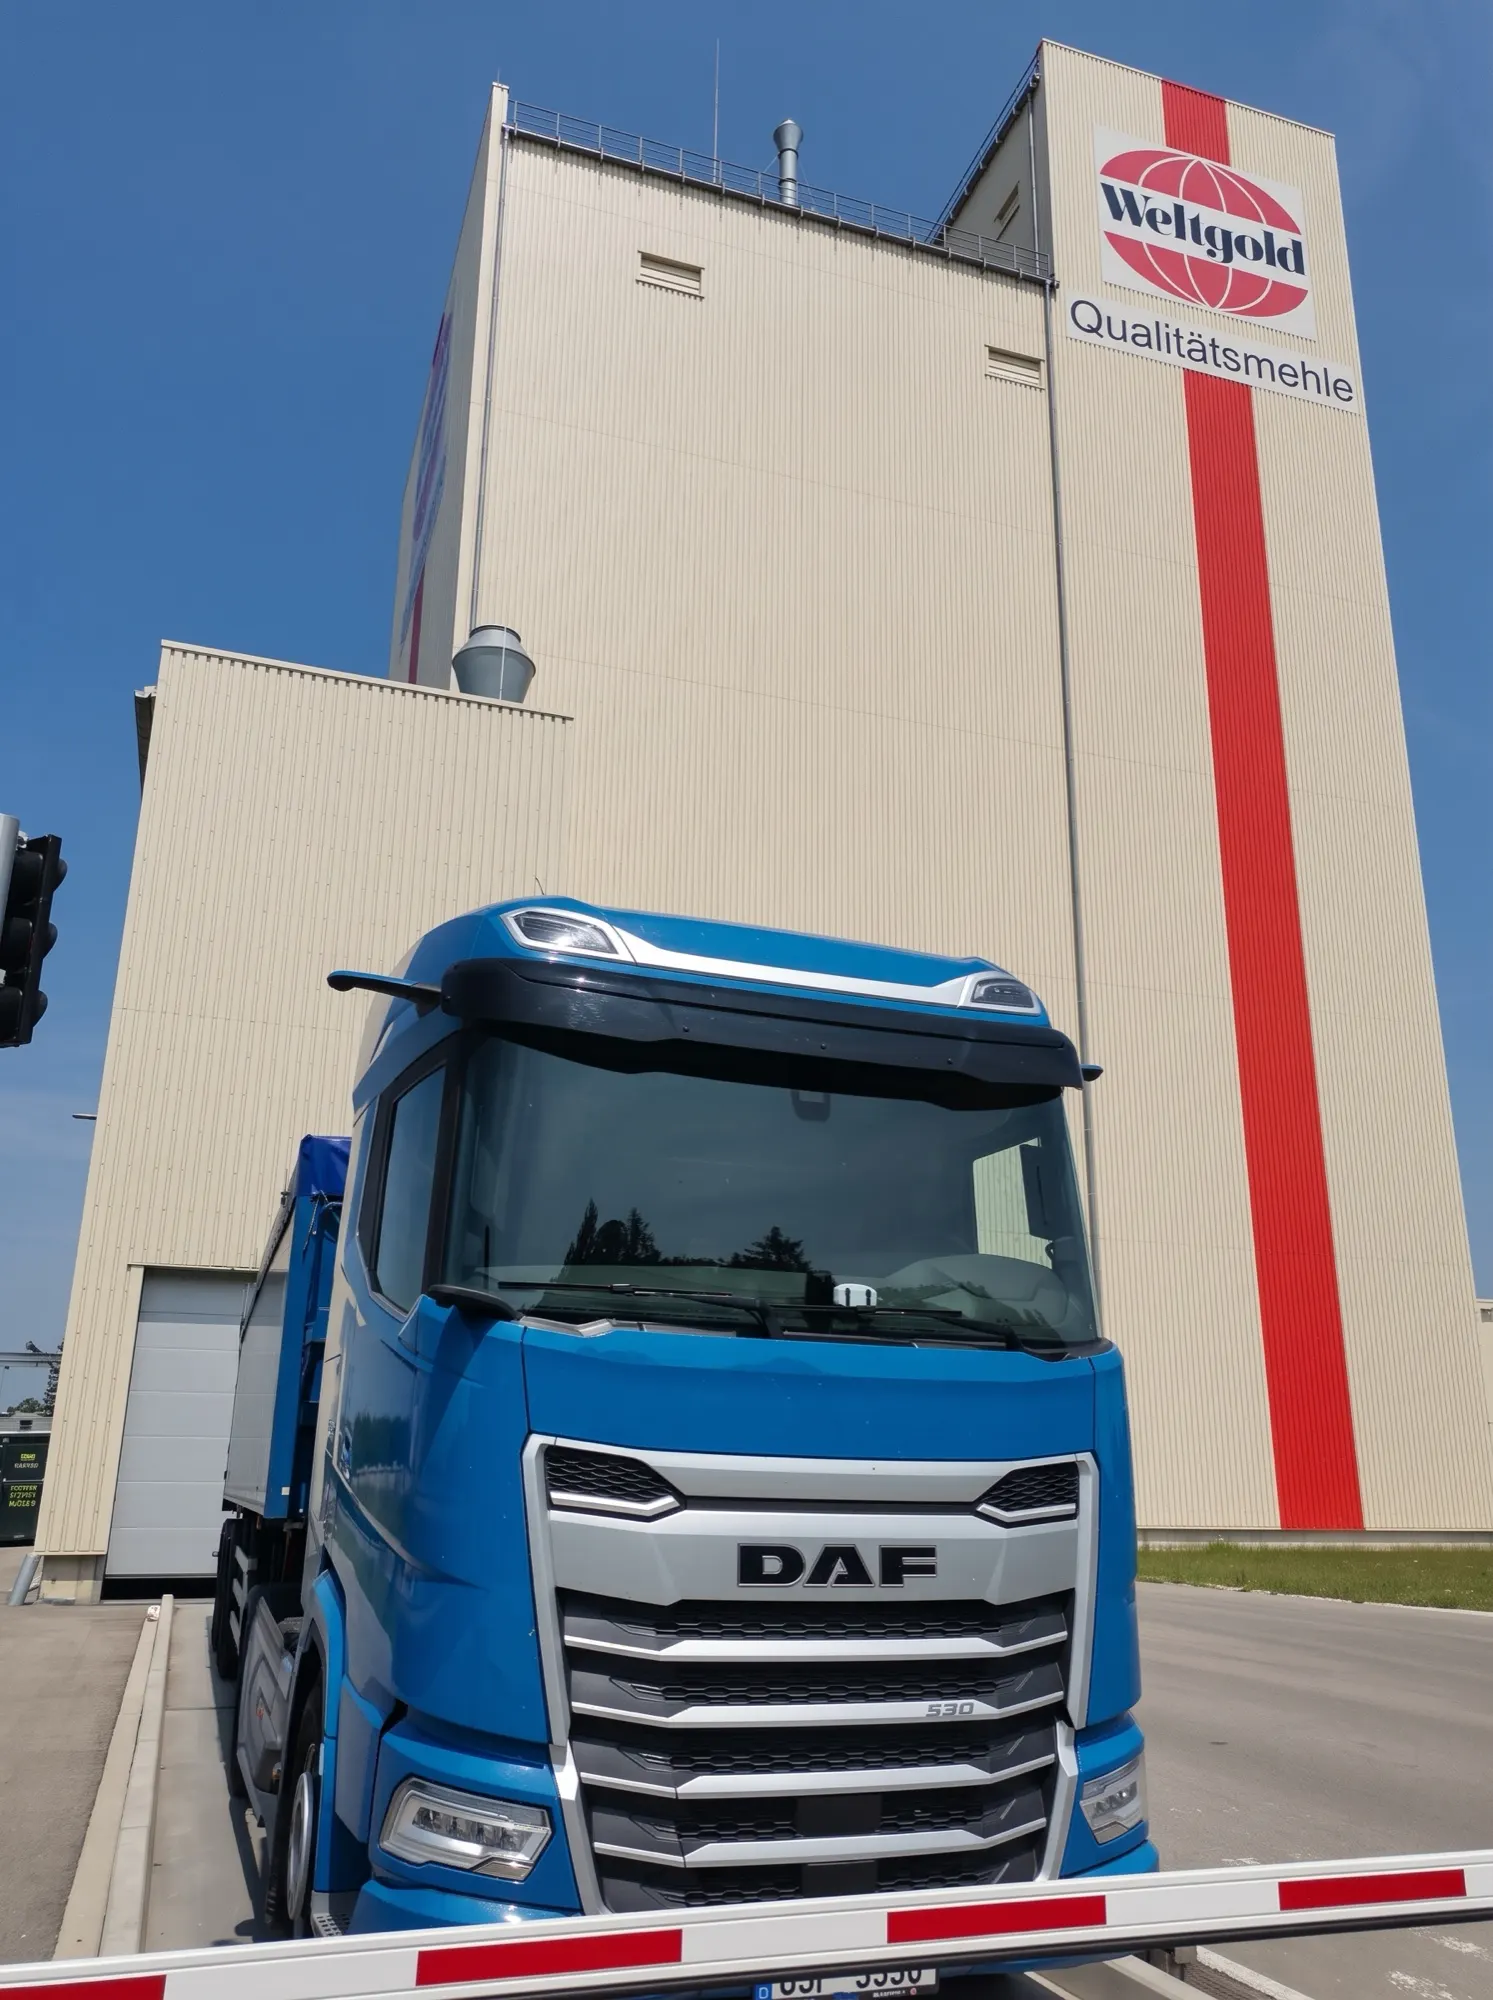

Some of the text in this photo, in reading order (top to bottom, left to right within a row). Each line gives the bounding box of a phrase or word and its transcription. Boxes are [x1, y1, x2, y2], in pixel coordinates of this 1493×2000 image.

[1100, 182, 1306, 276] Weltgold
[1070, 299, 1353, 403] Qualitätsmehle
[738, 1543, 937, 1588] DAF
[925, 1702, 975, 1717] 530
